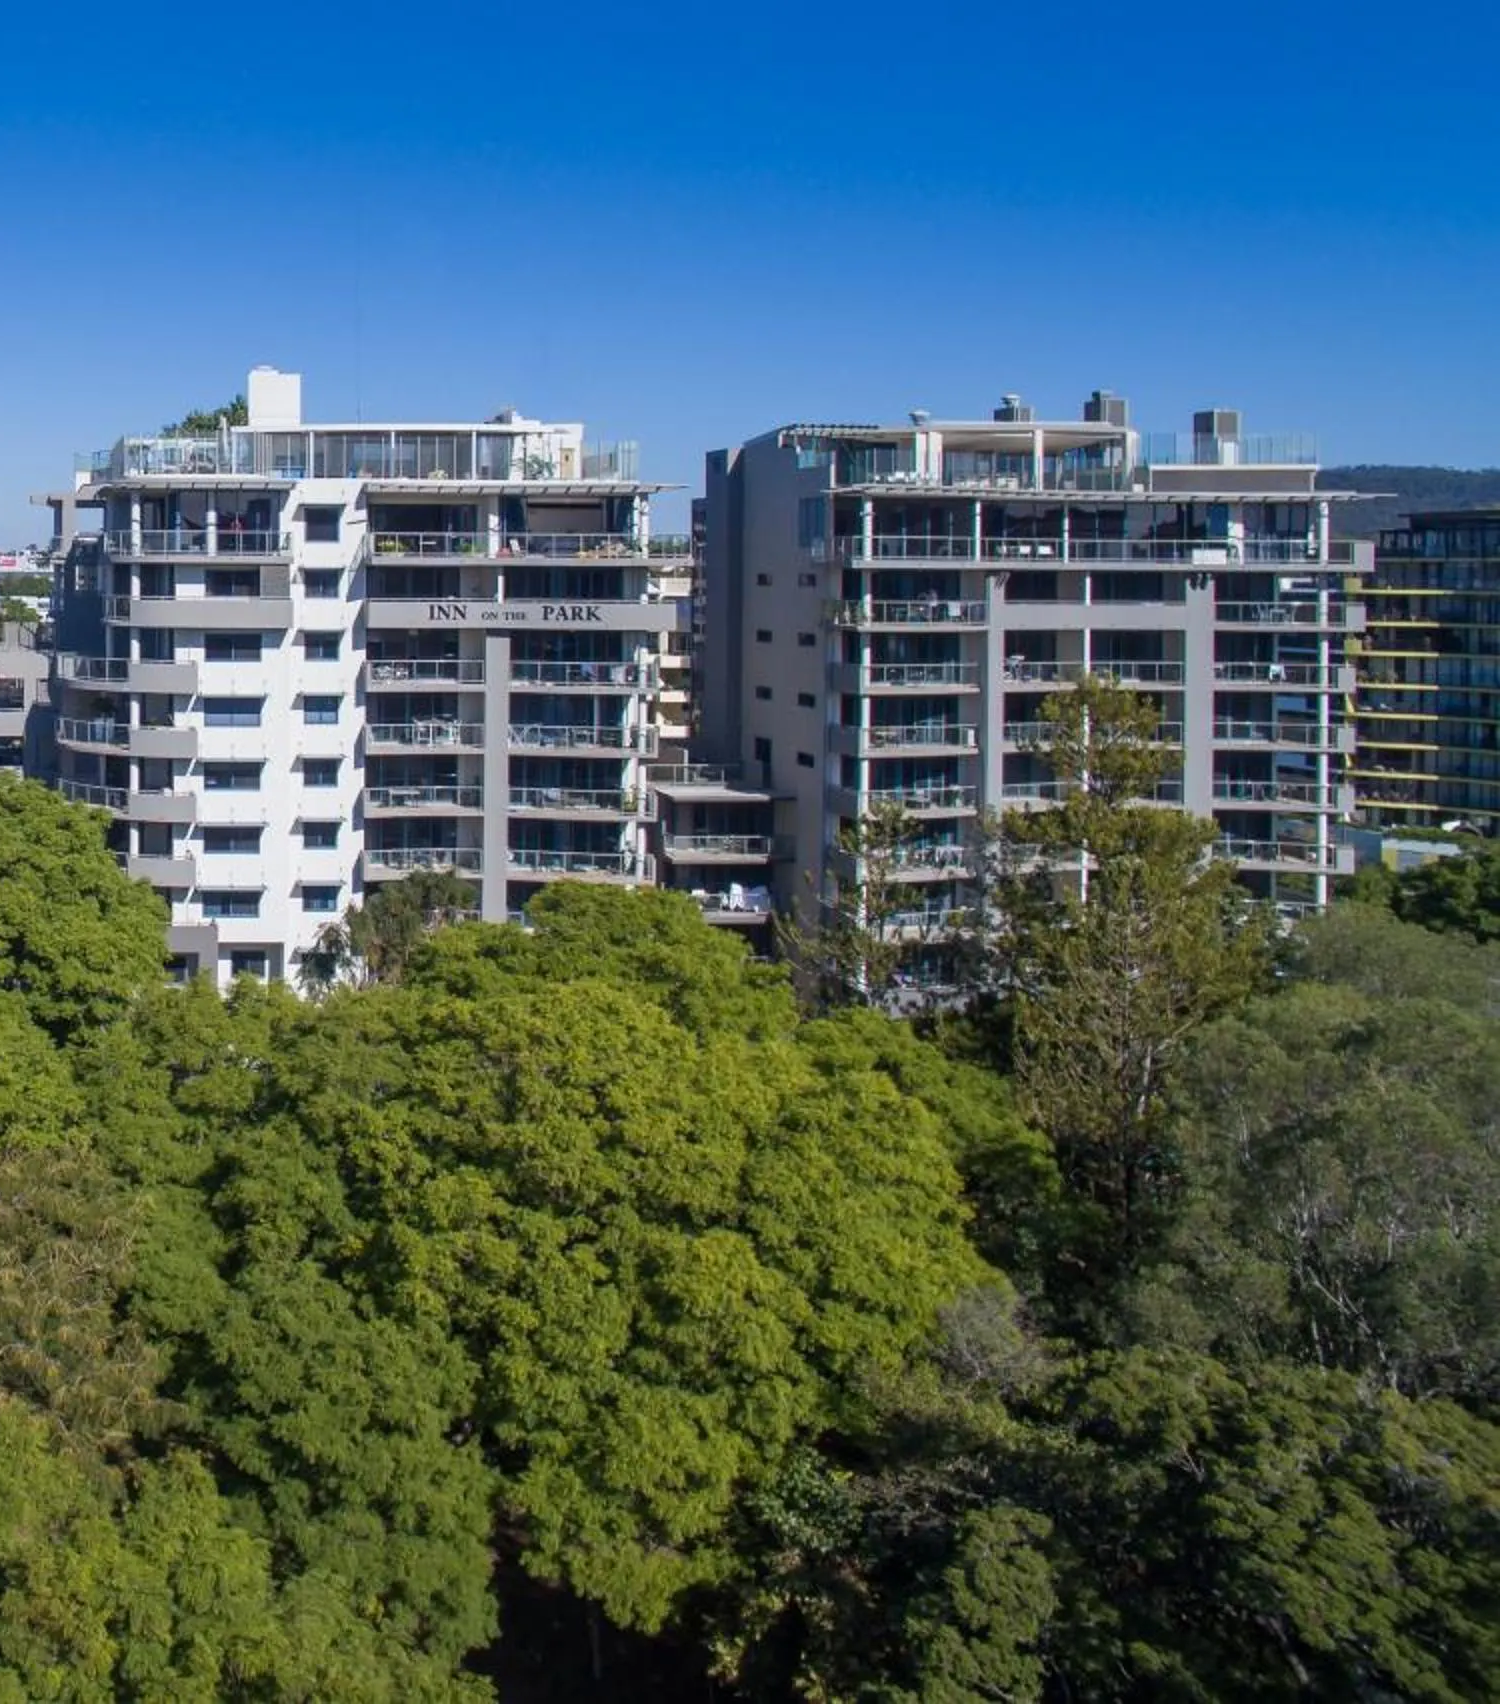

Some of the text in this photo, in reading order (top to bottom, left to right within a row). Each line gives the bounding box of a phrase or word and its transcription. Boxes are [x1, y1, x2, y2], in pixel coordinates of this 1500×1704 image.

[428, 604, 602, 622] INN ON THE PARK
